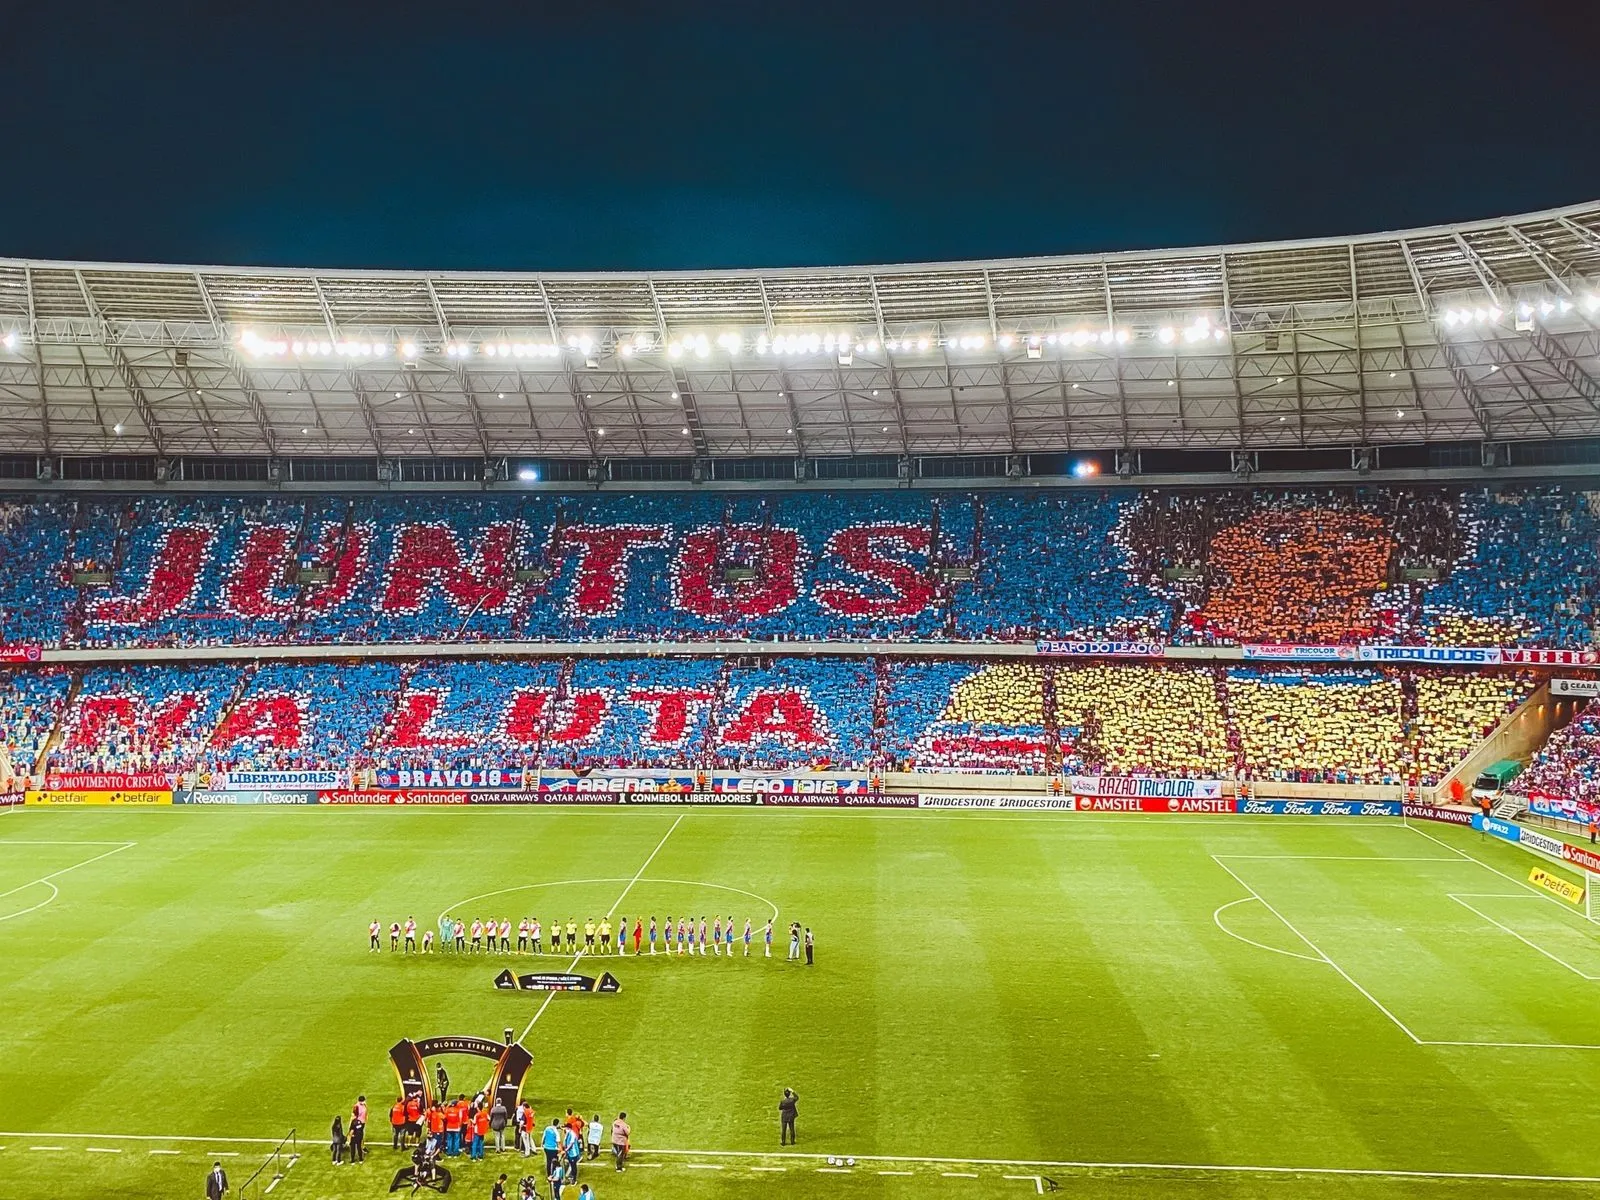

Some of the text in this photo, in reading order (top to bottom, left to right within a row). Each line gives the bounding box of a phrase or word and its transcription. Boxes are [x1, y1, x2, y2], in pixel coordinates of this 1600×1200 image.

[83, 518, 935, 625] JUNTOS
[1050, 642, 1087, 653] BAFO
[1089, 643, 1110, 653] DO
[1373, 648, 1485, 661] TRICOLOUCOS
[1523, 651, 1580, 664] BEER
[393, 685, 832, 747] LUTA
[63, 774, 165, 789] MOVIMENTO CRISTÃO
[228, 771, 336, 784] LIBERTADORES
[398, 770, 501, 787] BRAVO 18
[576, 778, 656, 792] ARENA
[1138, 779, 1195, 797] TRICOLOR
[0, 794, 24, 804] WAYS
[50, 792, 161, 803] betfair betfair
[193, 791, 308, 804] Rexona Rexona
[332, 792, 466, 804] Santander Santander
[470, 793, 613, 803] QATAR AIRWAYS QATAR AIRWAYS
[630, 793, 752, 803] CONMEBOL LIBERTADORES
[769, 794, 916, 805] QATAR AIRWAYS QATAR AIRWAYS
[924, 796, 1072, 809] BRIDGESTONE BRIDGESTONE
[1093, 799, 1232, 812] AMSTEL AMSTEL
[1243, 800, 1392, 816] Ford Ford Ford Ford
[1405, 806, 1434, 817] QATAR
[1435, 810, 1473, 824] AIRWAYS
[1521, 830, 1562, 855] BRIDGESTONE
[1543, 875, 1578, 898] betfair
[467, 1042, 497, 1053] ETERNA
